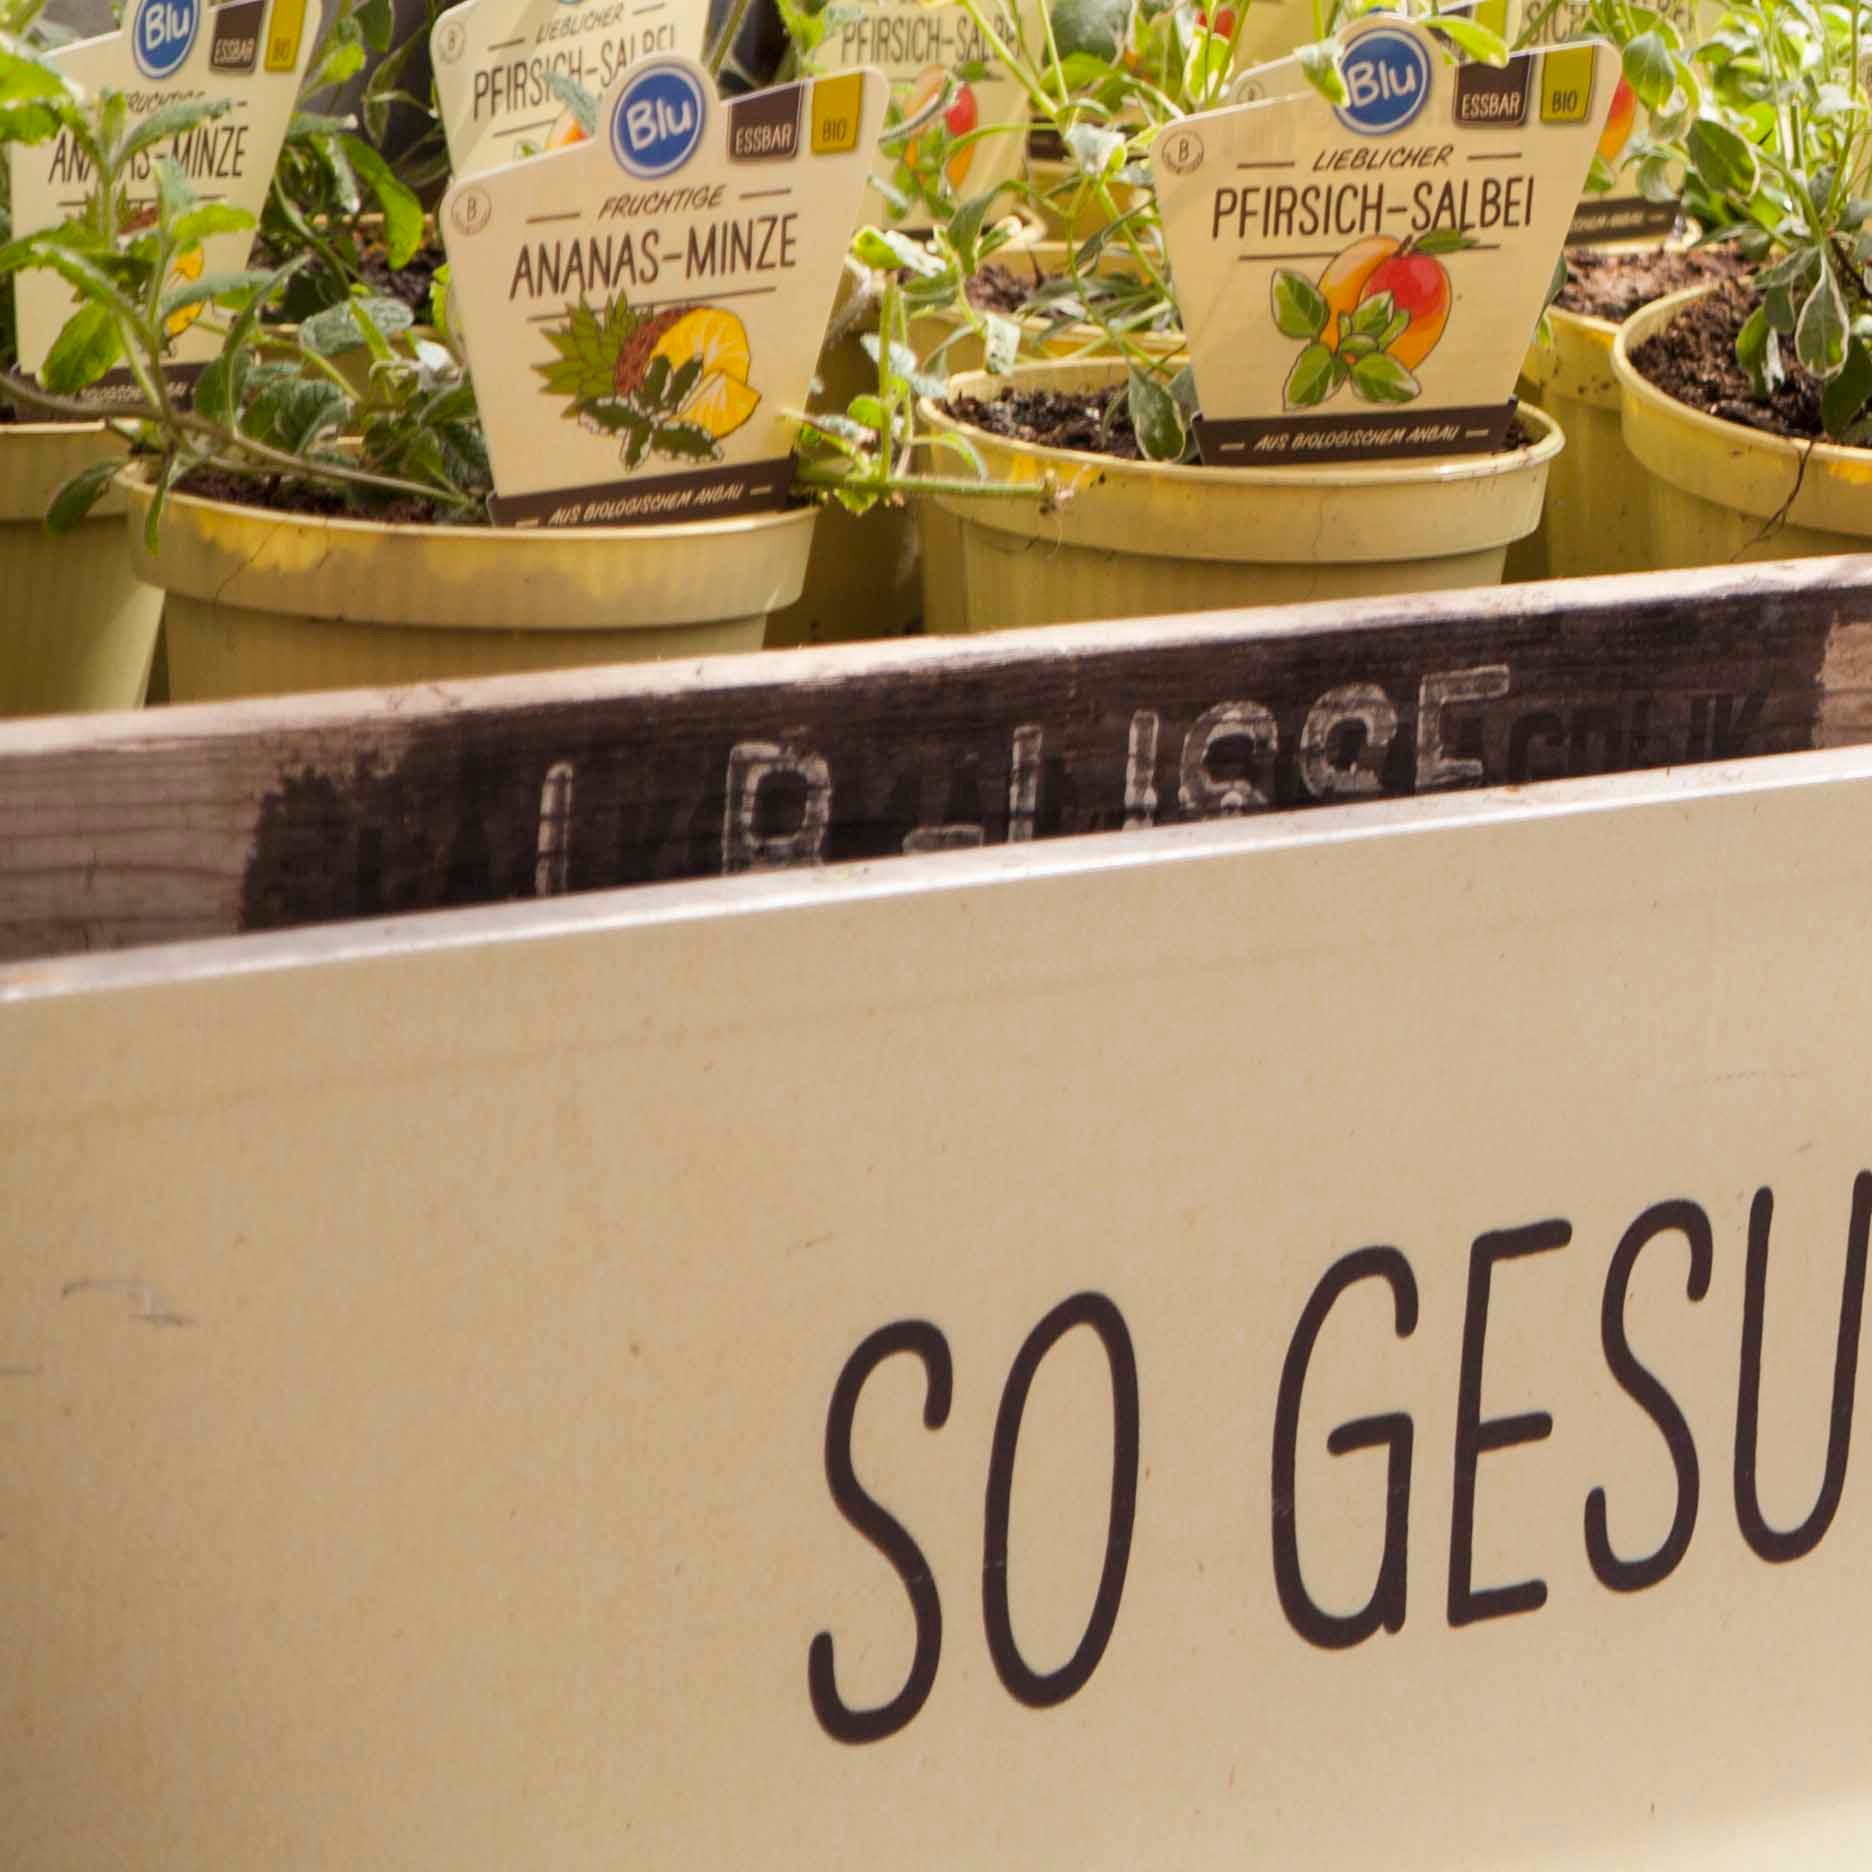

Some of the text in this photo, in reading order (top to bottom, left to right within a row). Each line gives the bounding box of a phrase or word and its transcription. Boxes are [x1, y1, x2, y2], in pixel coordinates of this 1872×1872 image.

[145, 3, 190, 50] Blu
[535, 1, 625, 45] LIEBLICHER
[214, 37, 254, 64] ESSBAR
[1346, 58, 1417, 108] Blu
[1551, 90, 1578, 113] BIO
[626, 98, 692, 151] Blu
[821, 117, 848, 143] BIO
[1461, 96, 1521, 120] ESSBAR
[48, 125, 249, 184] ANAS-MINZE
[735, 123, 793, 154] ESSBAR
[1312, 144, 1455, 173] LIEBLICHER
[598, 184, 728, 220] FRUCHTIGE
[1211, 175, 1535, 240] PFIRSICH-SALBEI
[509, 212, 798, 301] ANANAS-MINZE
[1254, 425, 1461, 451] AUS BIOLOGISCHEM ANBAU
[549, 481, 745, 525] AUS BIOLOGISCHEM ANBAU
[808, 1288, 1141, 1747] SO
